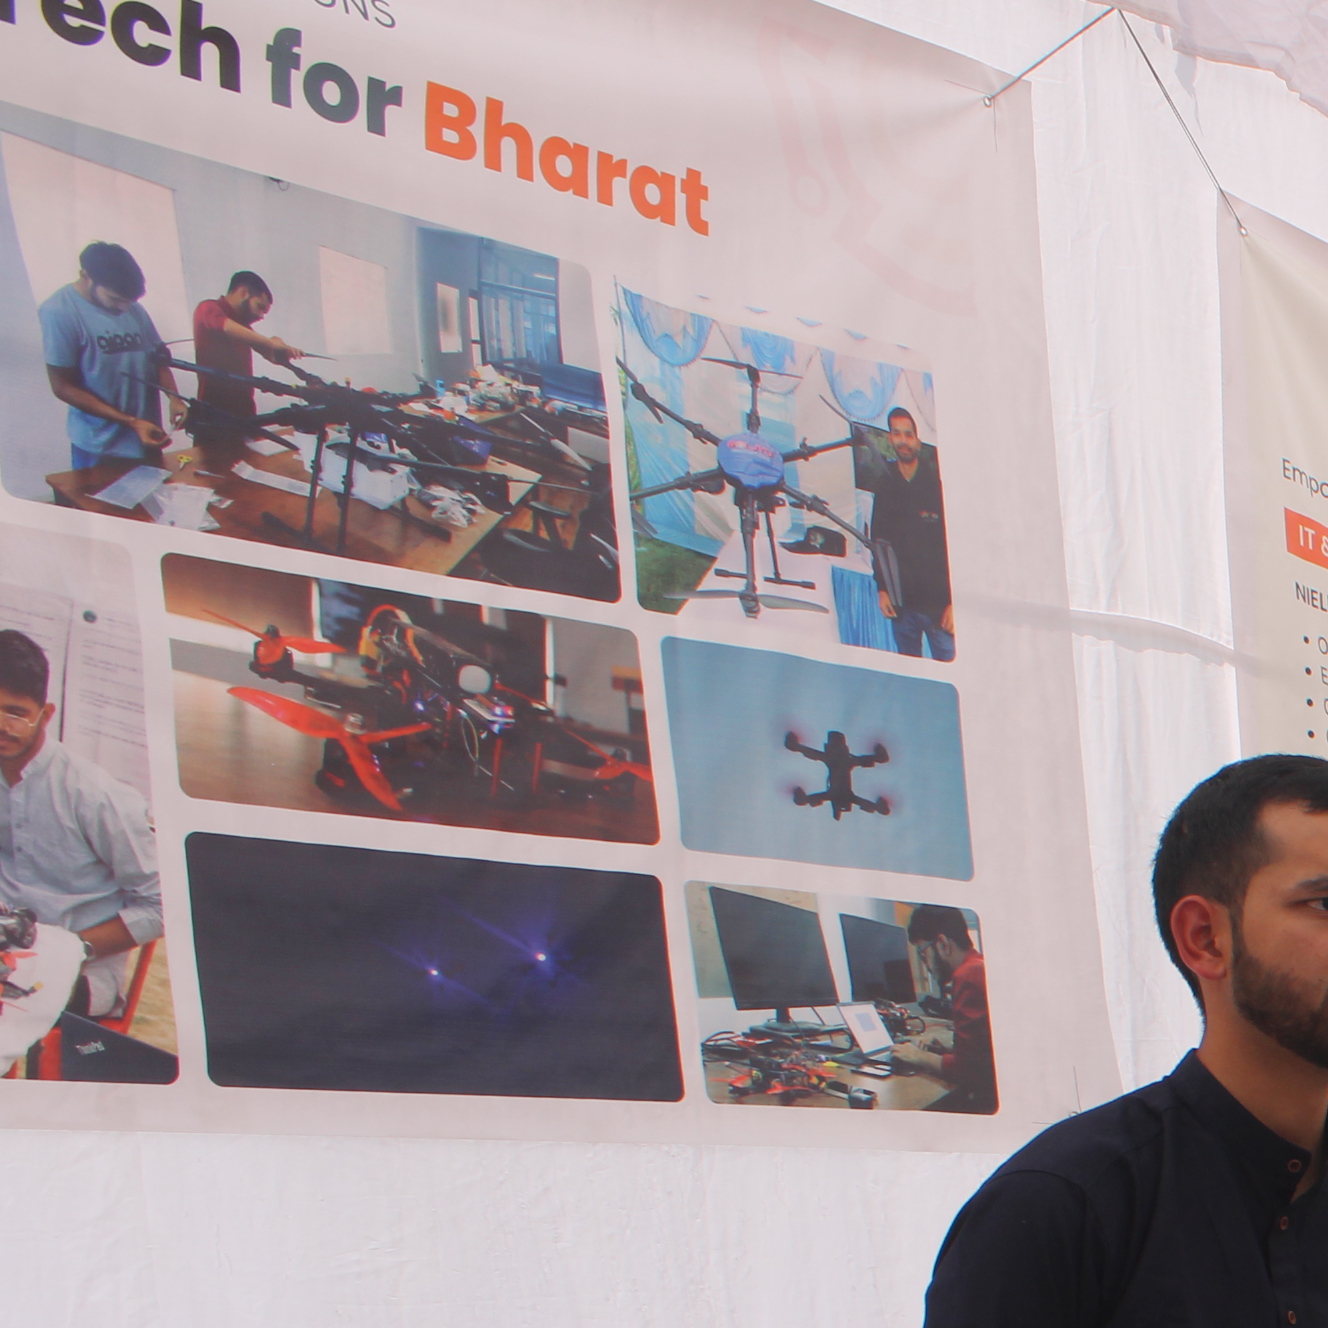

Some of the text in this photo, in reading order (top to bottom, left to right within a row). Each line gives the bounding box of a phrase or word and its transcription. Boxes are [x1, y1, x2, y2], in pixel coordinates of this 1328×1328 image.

[0, 0, 710, 236] ech for Bharat
[1298, 524, 1316, 550] IT
[1317, 636, 1328, 655] O
